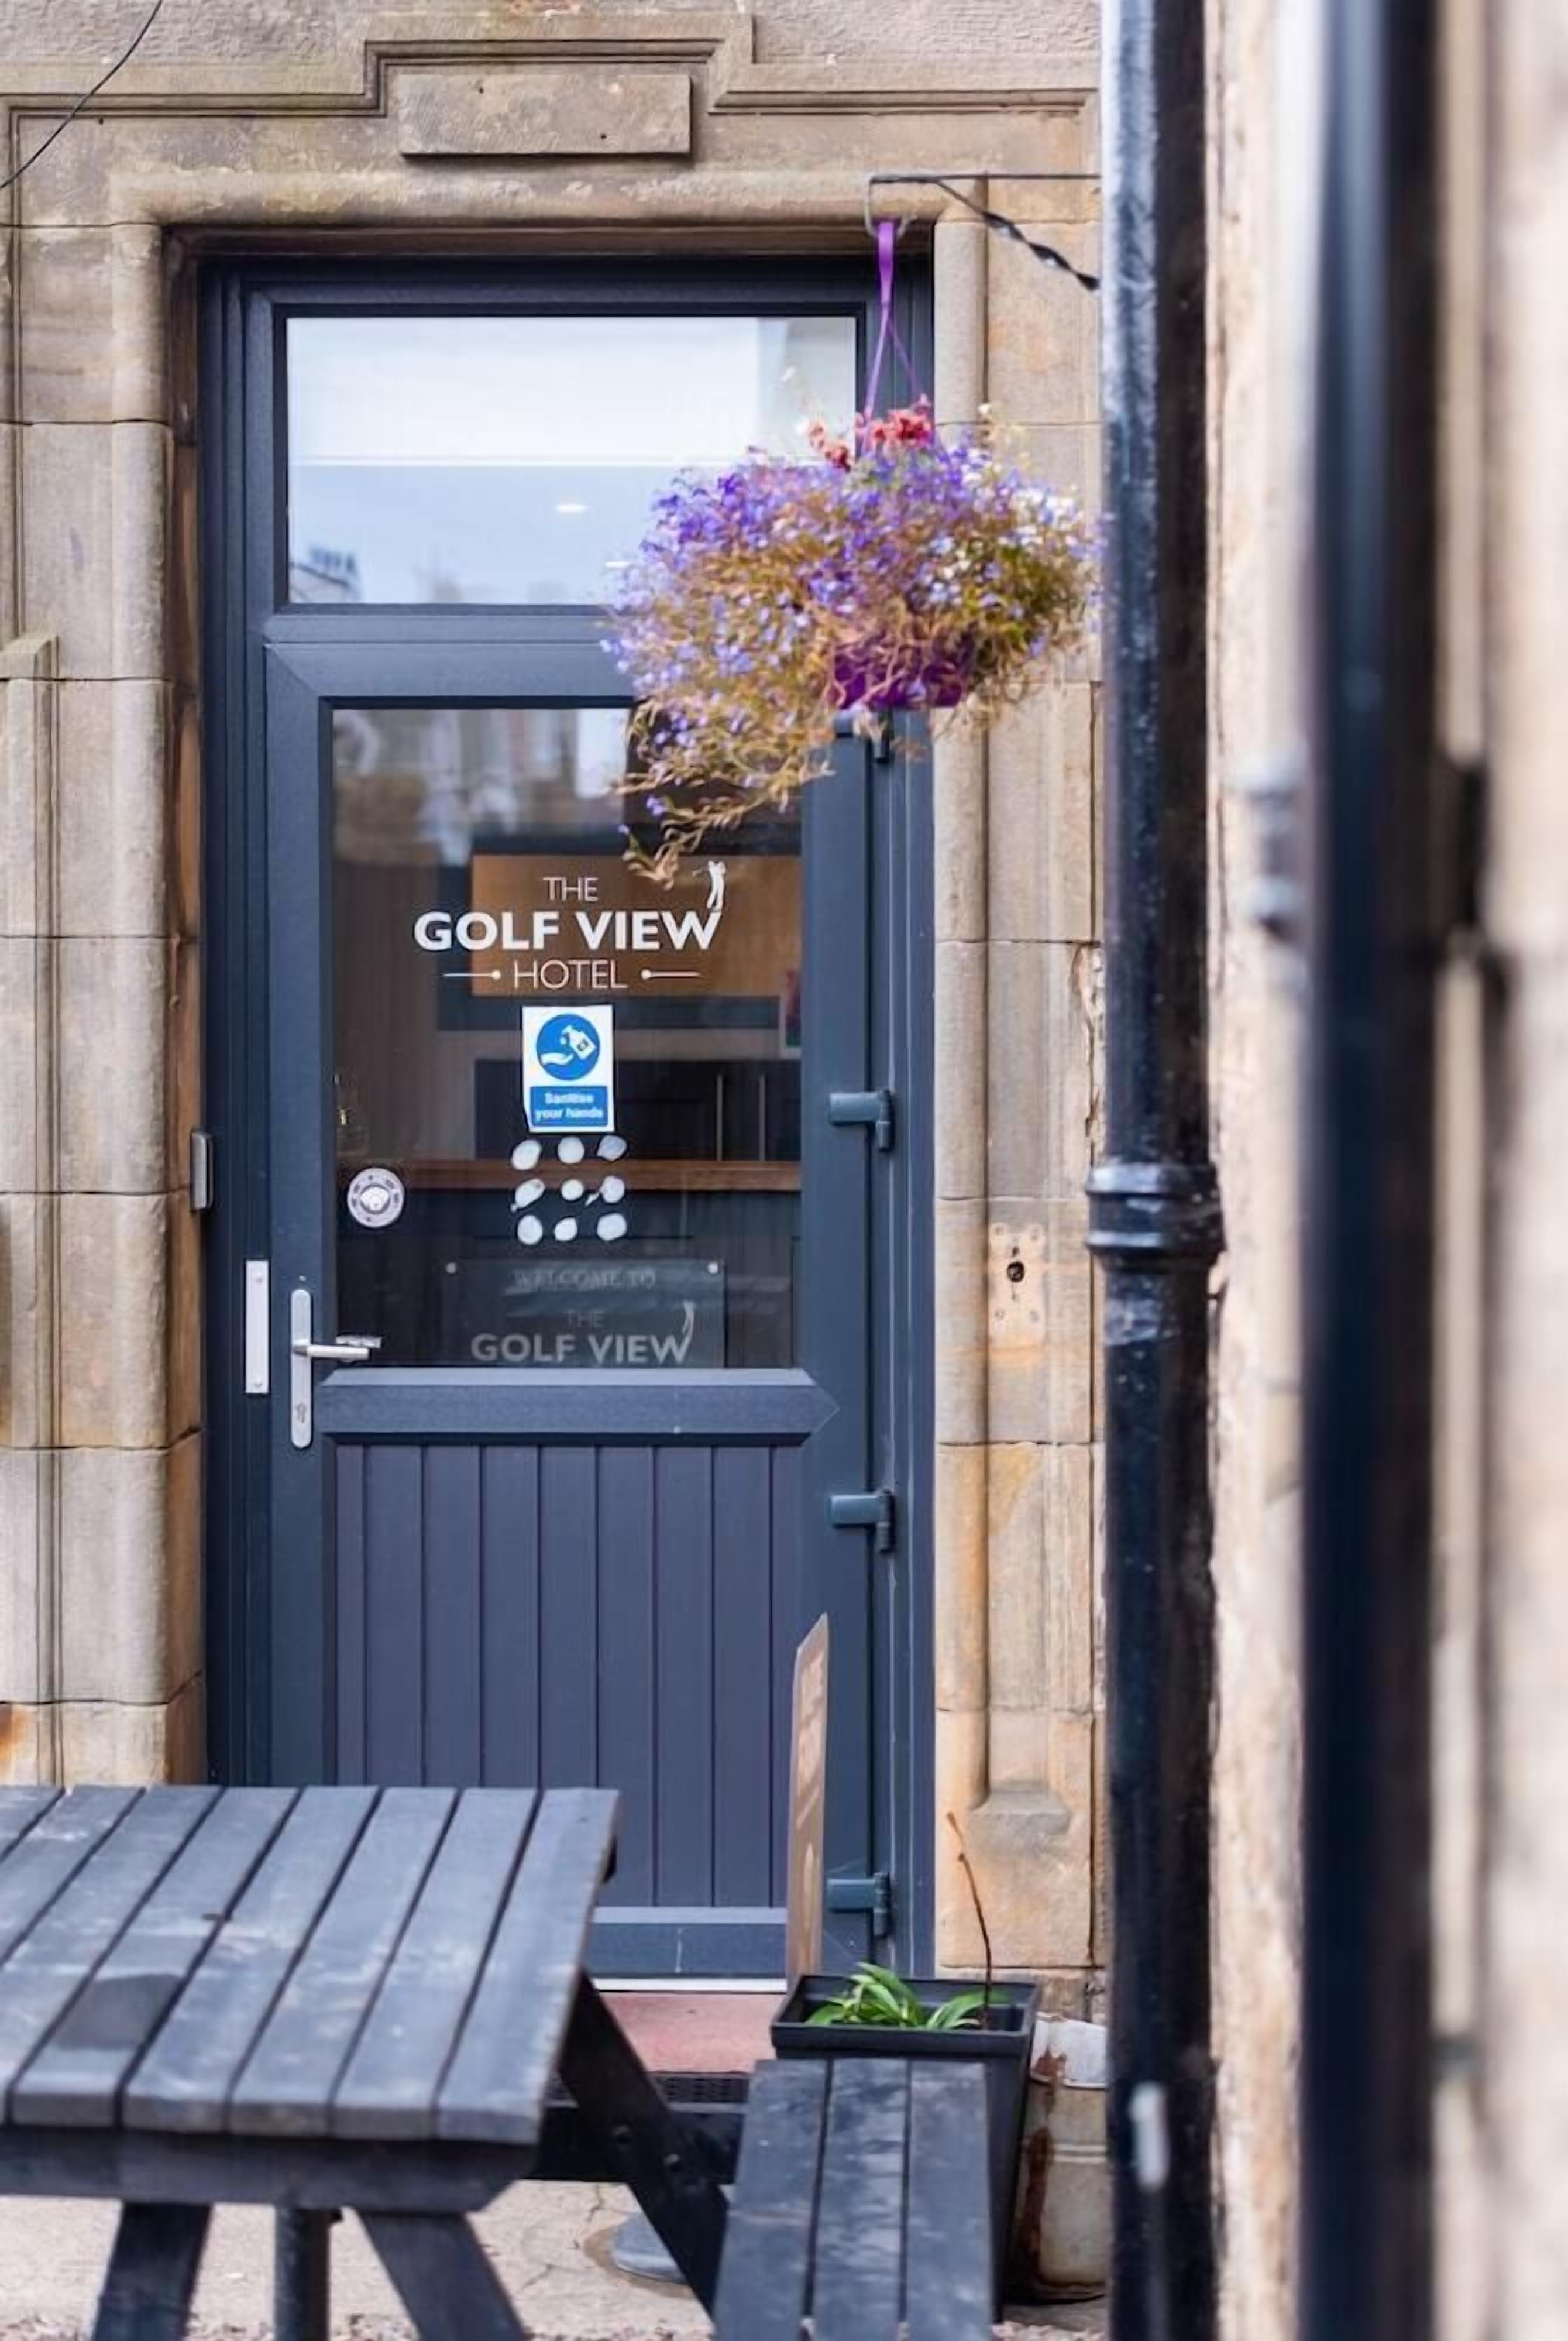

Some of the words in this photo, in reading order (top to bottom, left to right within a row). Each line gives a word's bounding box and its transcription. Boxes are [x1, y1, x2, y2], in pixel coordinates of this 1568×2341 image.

[543, 877, 599, 902] THE
[414, 910, 559, 951] GOLF
[576, 910, 722, 951] VIEW
[514, 959, 628, 990] HOTEL
[535, 1108, 564, 1122] your
[566, 1106, 604, 1118] hands
[566, 1310, 604, 1328] THE
[470, 1332, 576, 1362] GOLF
[587, 1334, 692, 1364] VIEW
